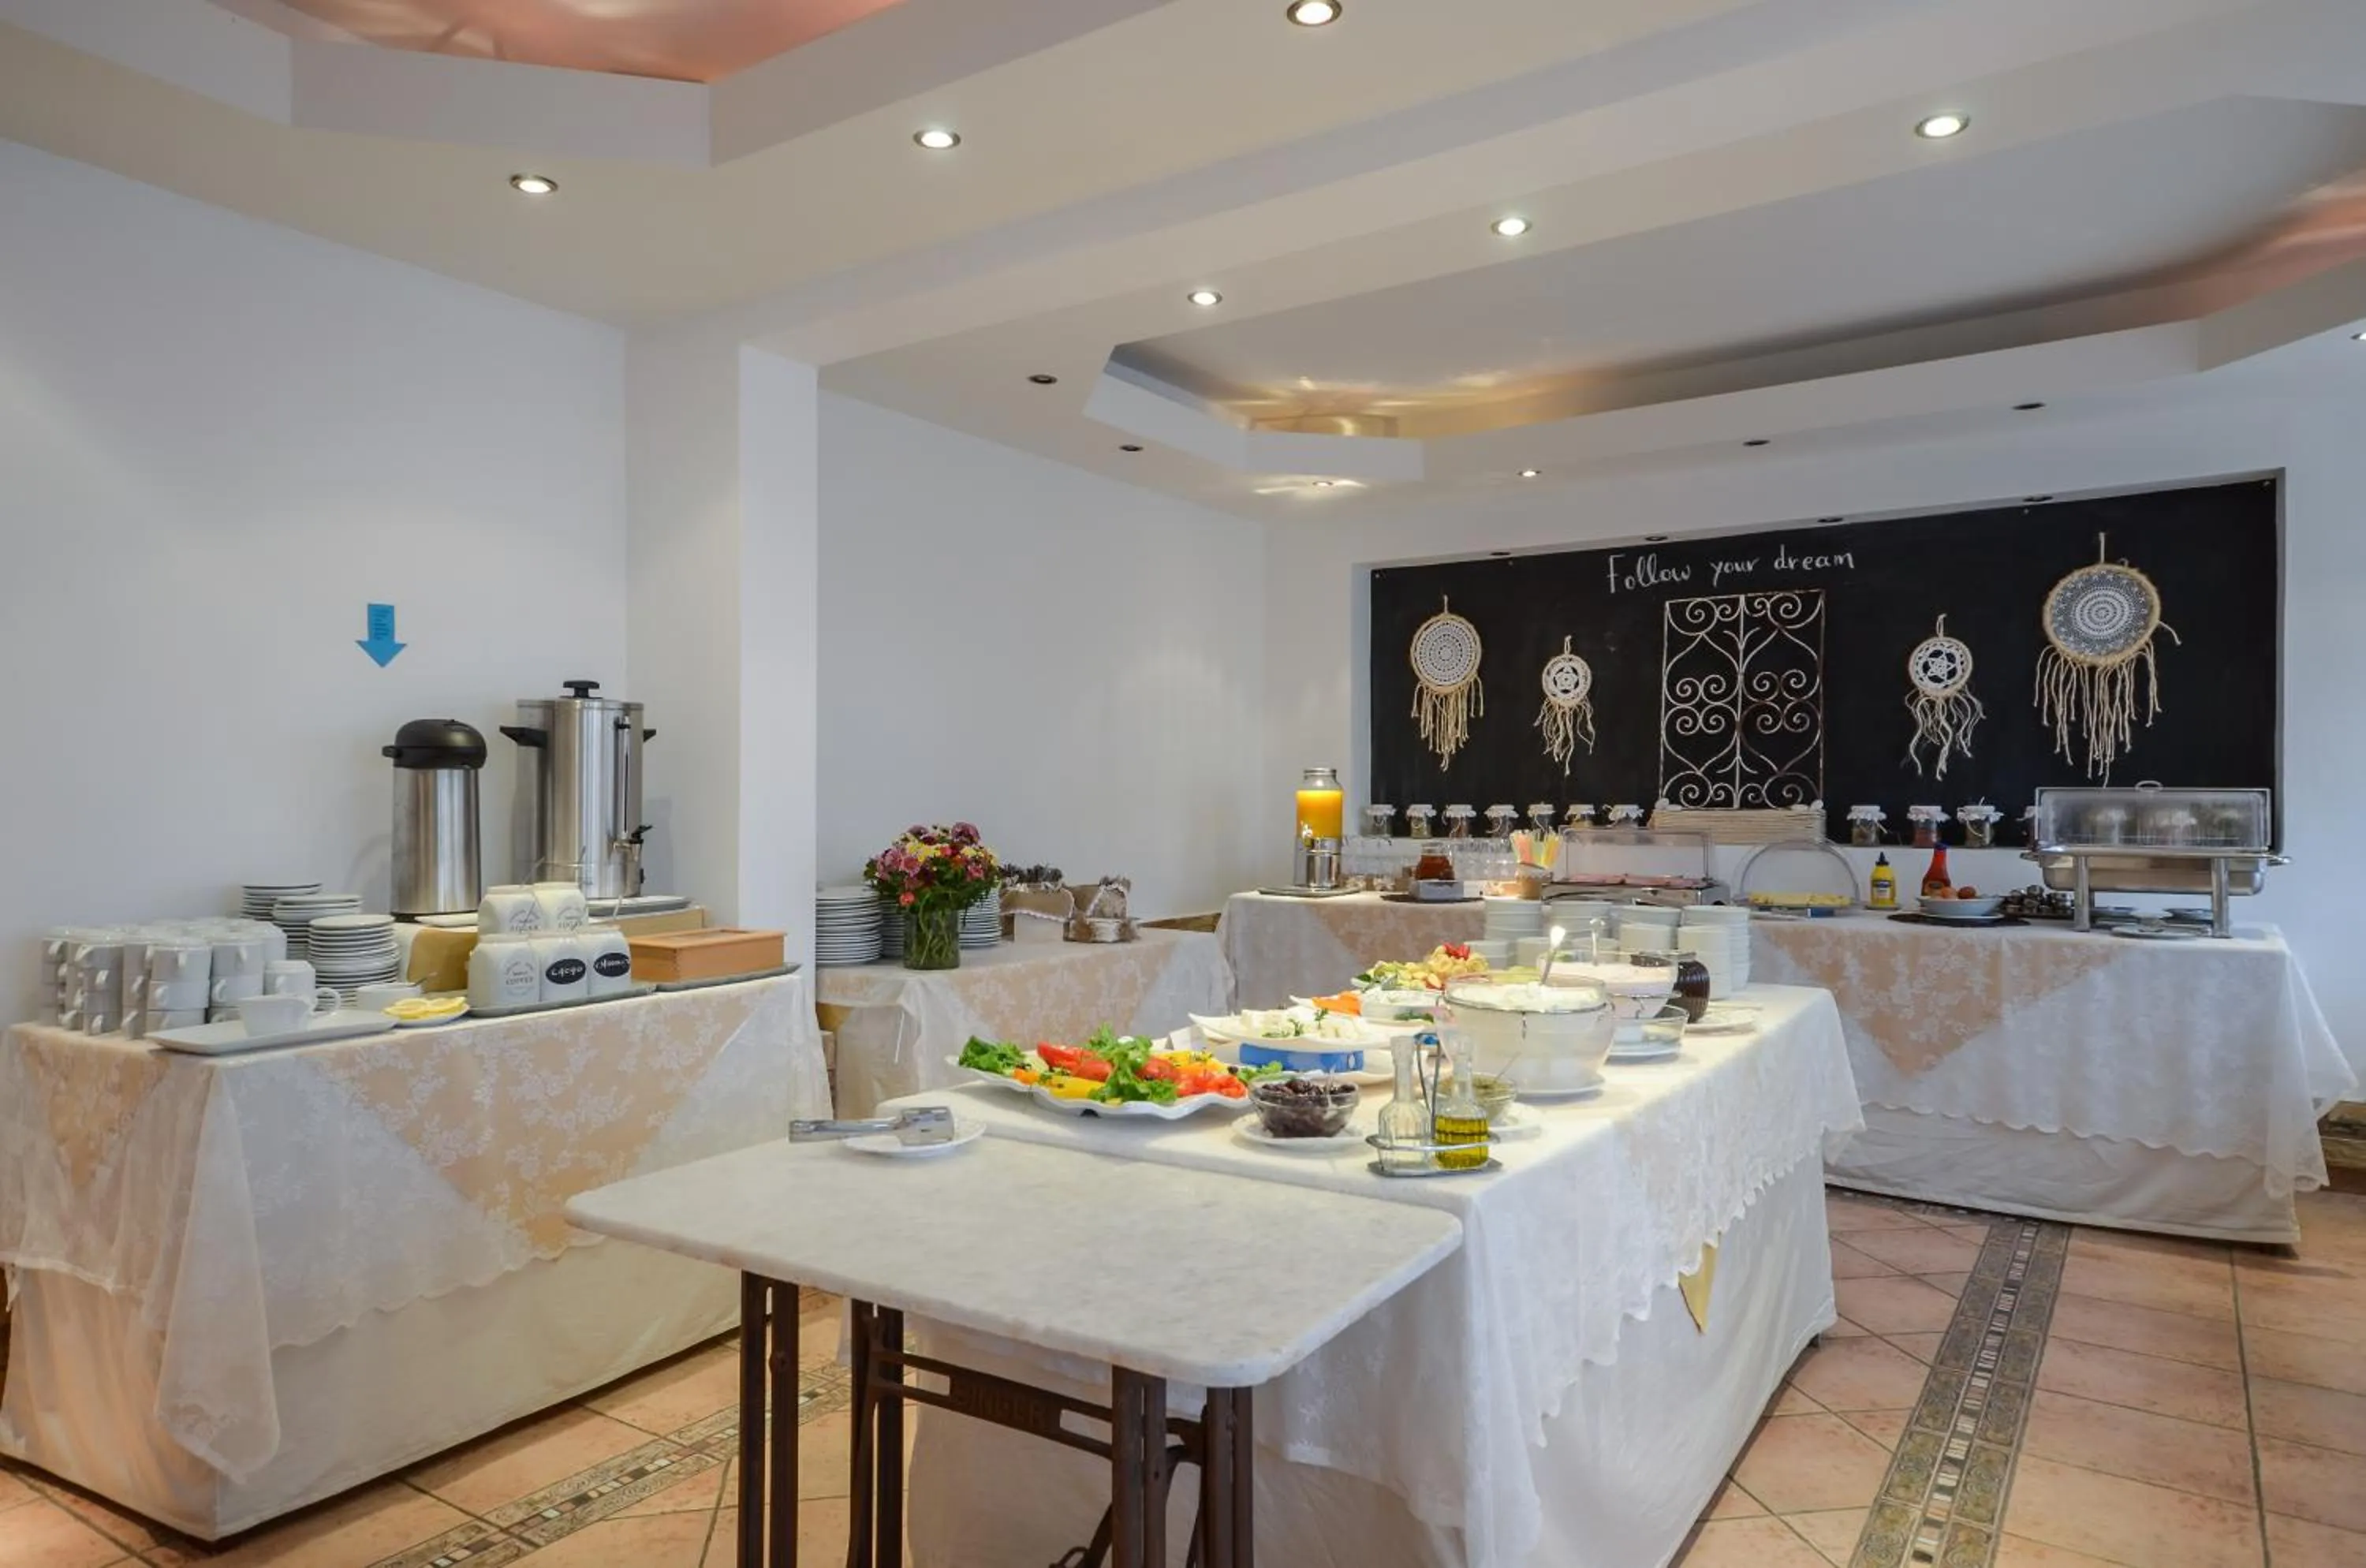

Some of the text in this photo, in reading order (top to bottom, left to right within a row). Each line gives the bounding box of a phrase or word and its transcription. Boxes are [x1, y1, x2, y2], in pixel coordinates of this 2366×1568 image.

[1607, 544, 1855, 594] Follow your dream
